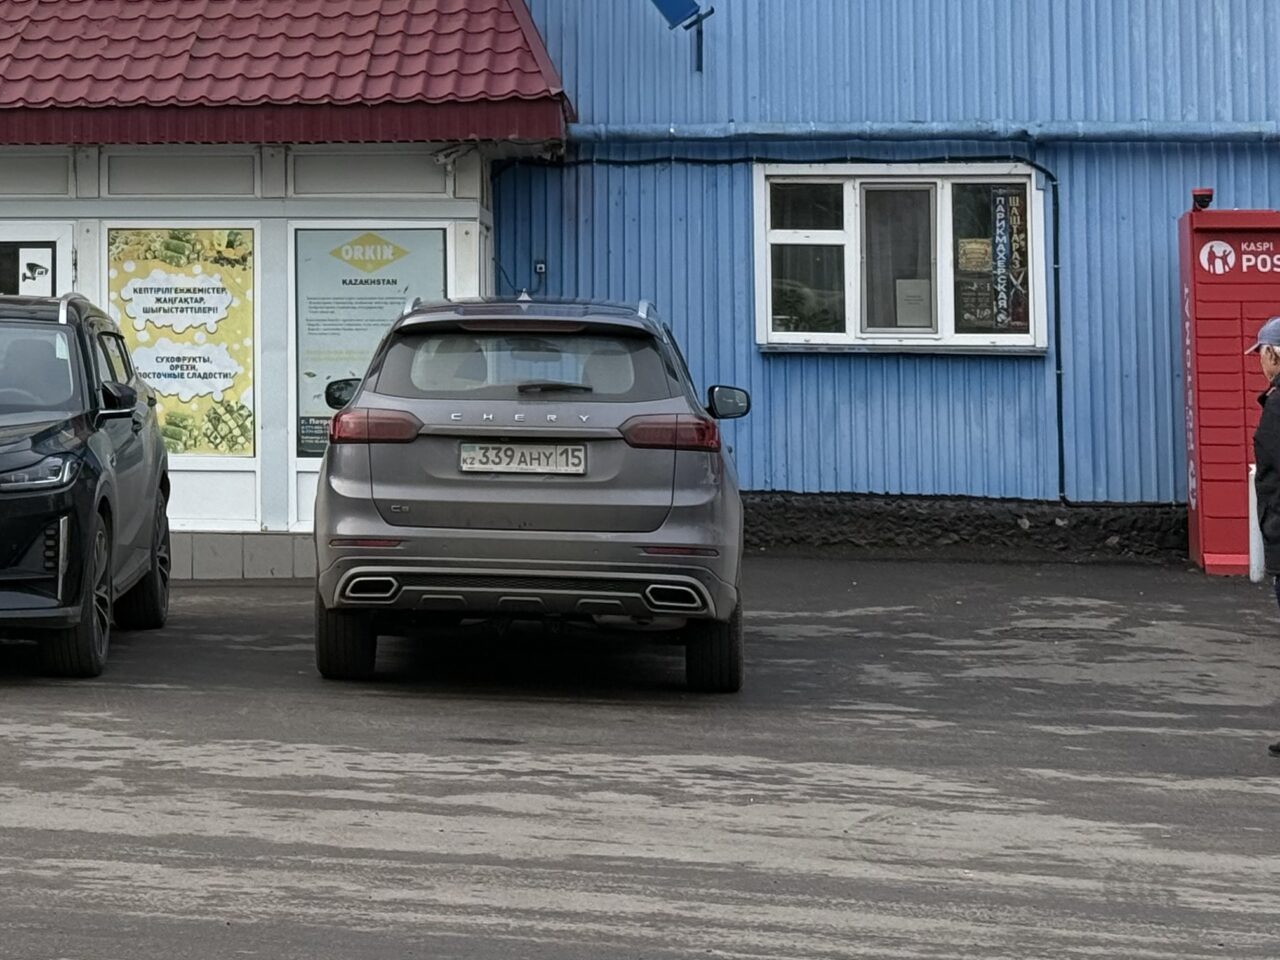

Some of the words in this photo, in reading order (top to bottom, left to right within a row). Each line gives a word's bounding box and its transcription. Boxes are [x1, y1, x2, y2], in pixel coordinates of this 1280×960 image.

[1008, 195, 1021, 270] ШАШТАРАЗ
[1241, 241, 1274, 252] KASPI
[340, 244, 395, 261] ORKIN
[995, 196, 1009, 309] ПАРИКМАХЕРСКАЯ
[155, 356, 213, 364] СУХОФРУКТЫ,
[169, 364, 199, 372] ОРЕХИ,
[186, 372, 232, 380] СЛАДОСТИ!
[451, 413, 590, 423] CHERY
[462, 456, 476, 466] KZ
[478, 446, 554, 467] 339AHY
[559, 448, 583, 468] 15
